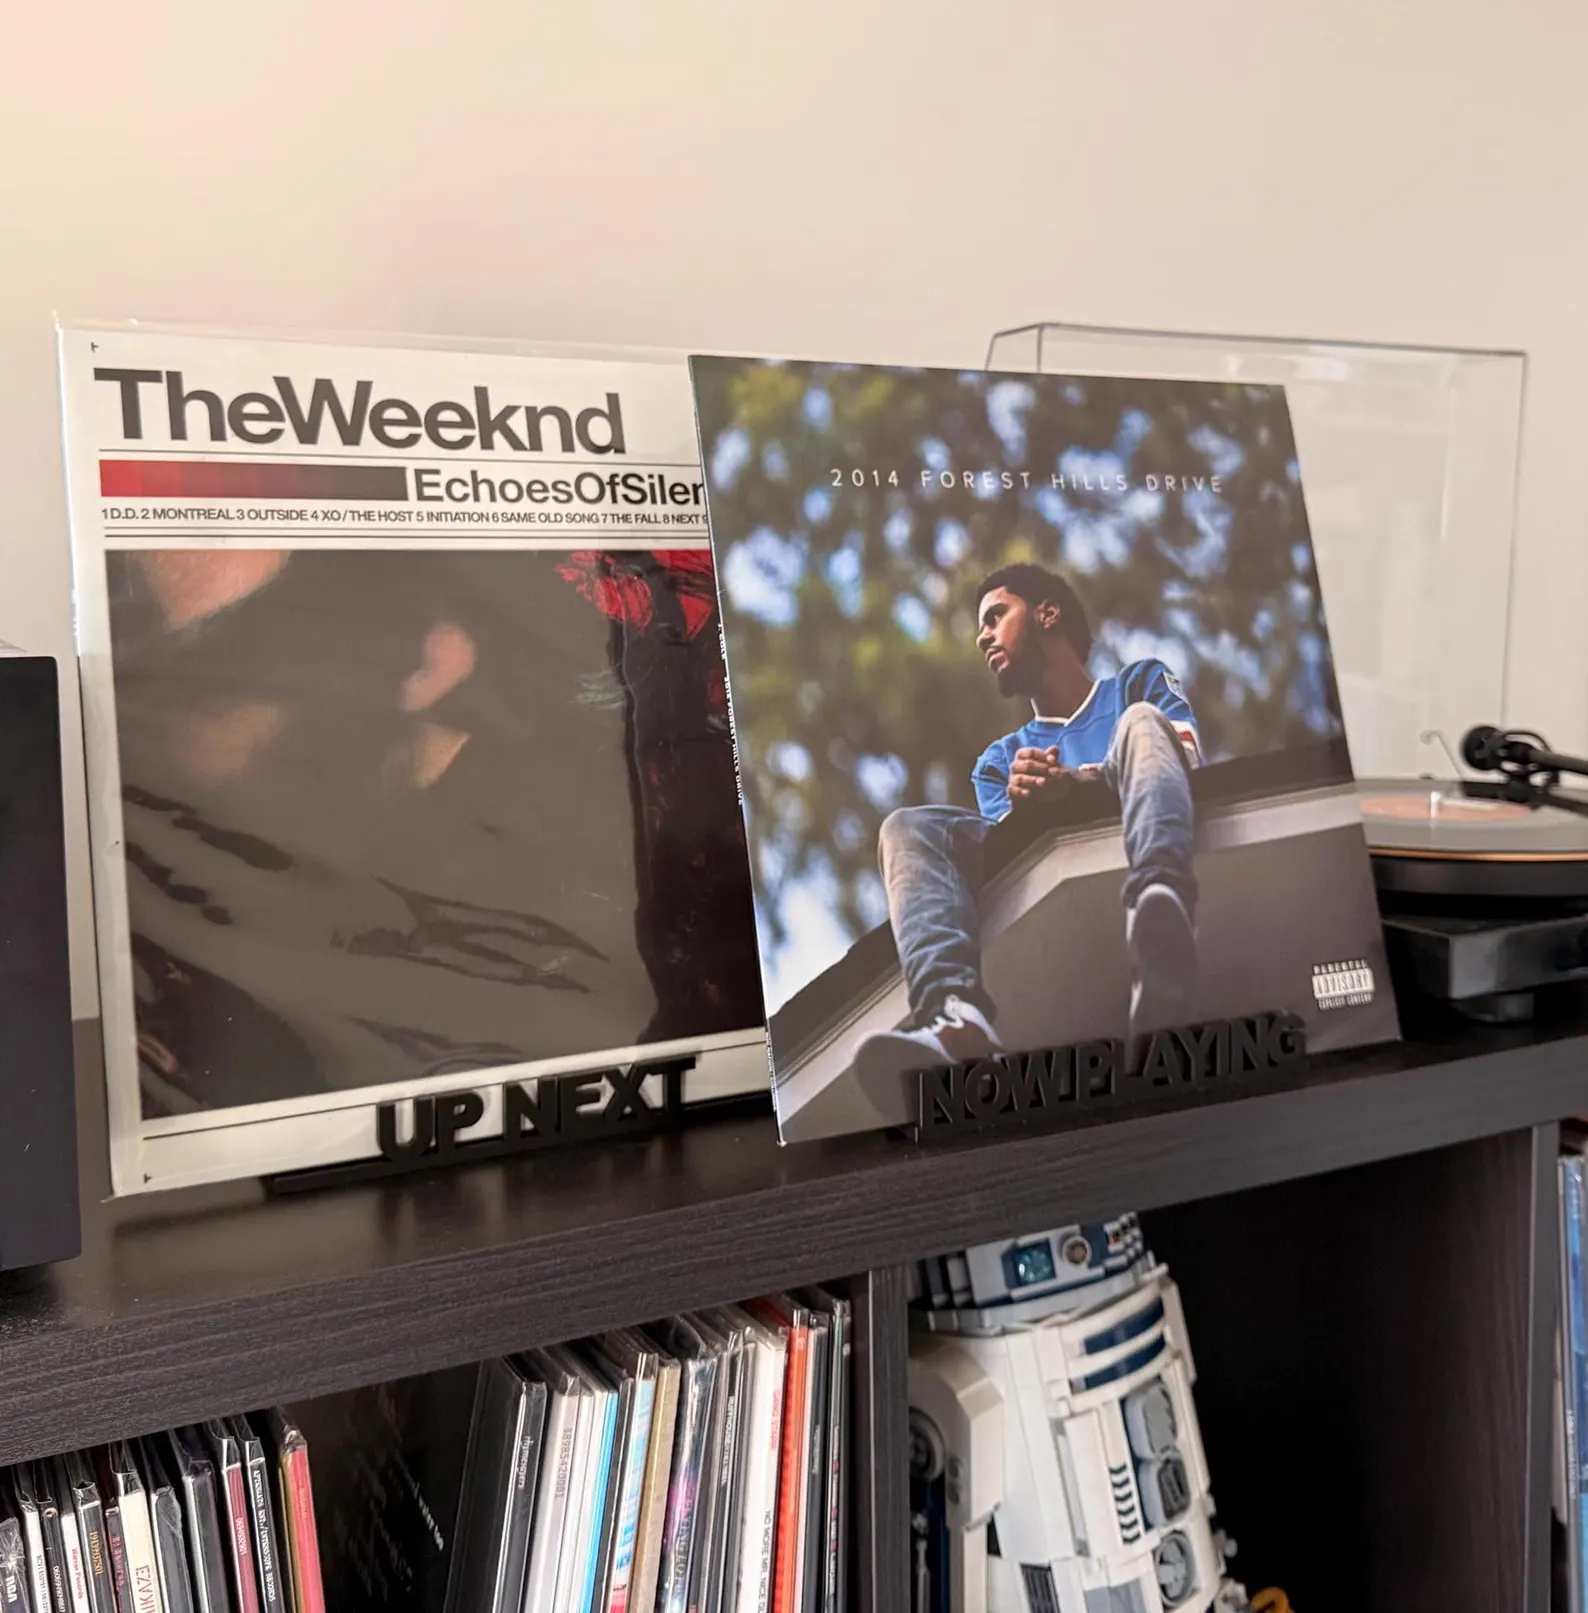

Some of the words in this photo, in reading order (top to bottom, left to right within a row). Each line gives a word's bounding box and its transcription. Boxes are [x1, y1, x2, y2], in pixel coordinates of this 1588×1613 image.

[93, 367, 627, 455] TheWeeknd
[831, 468, 899, 487] 2014
[921, 470, 1031, 490] FOREST
[1051, 472, 1129, 492] HILLS
[1146, 474, 1223, 494] DRIVE
[141, 508, 150, 521] 2
[153, 508, 234, 521] MONTREAL
[236, 509, 244, 522] 3
[247, 509, 308, 522] OUTSIDE
[310, 510, 319, 522] 4
[350, 510, 376, 522] THE
[378, 511, 413, 523] HOST
[416, 511, 424, 523] 5
[427, 511, 489, 523] INITIATION
[492, 512, 499, 523] 6
[501, 512, 536, 523] SAME
[538, 512, 563, 523] OLD
[565, 512, 599, 524] SONG
[602, 513, 609, 524] 7
[611, 513, 633, 524] THE
[635, 513, 661, 524] FALL
[663, 513, 670, 524] 8
[672, 513, 700, 524] NEXT
[727, 696, 737, 740] FOREST
[732, 741, 740, 772] HILLS
[735, 775, 743, 805] DRIVE
[376, 1088, 484, 1160] UP
[502, 1056, 697, 1142] NEXT
[764, 1510, 771, 1525] NO
[762, 1527, 770, 1555] MORE
[6, 1575, 18, 1604] RCA
[758, 1577, 767, 1600] NICE
